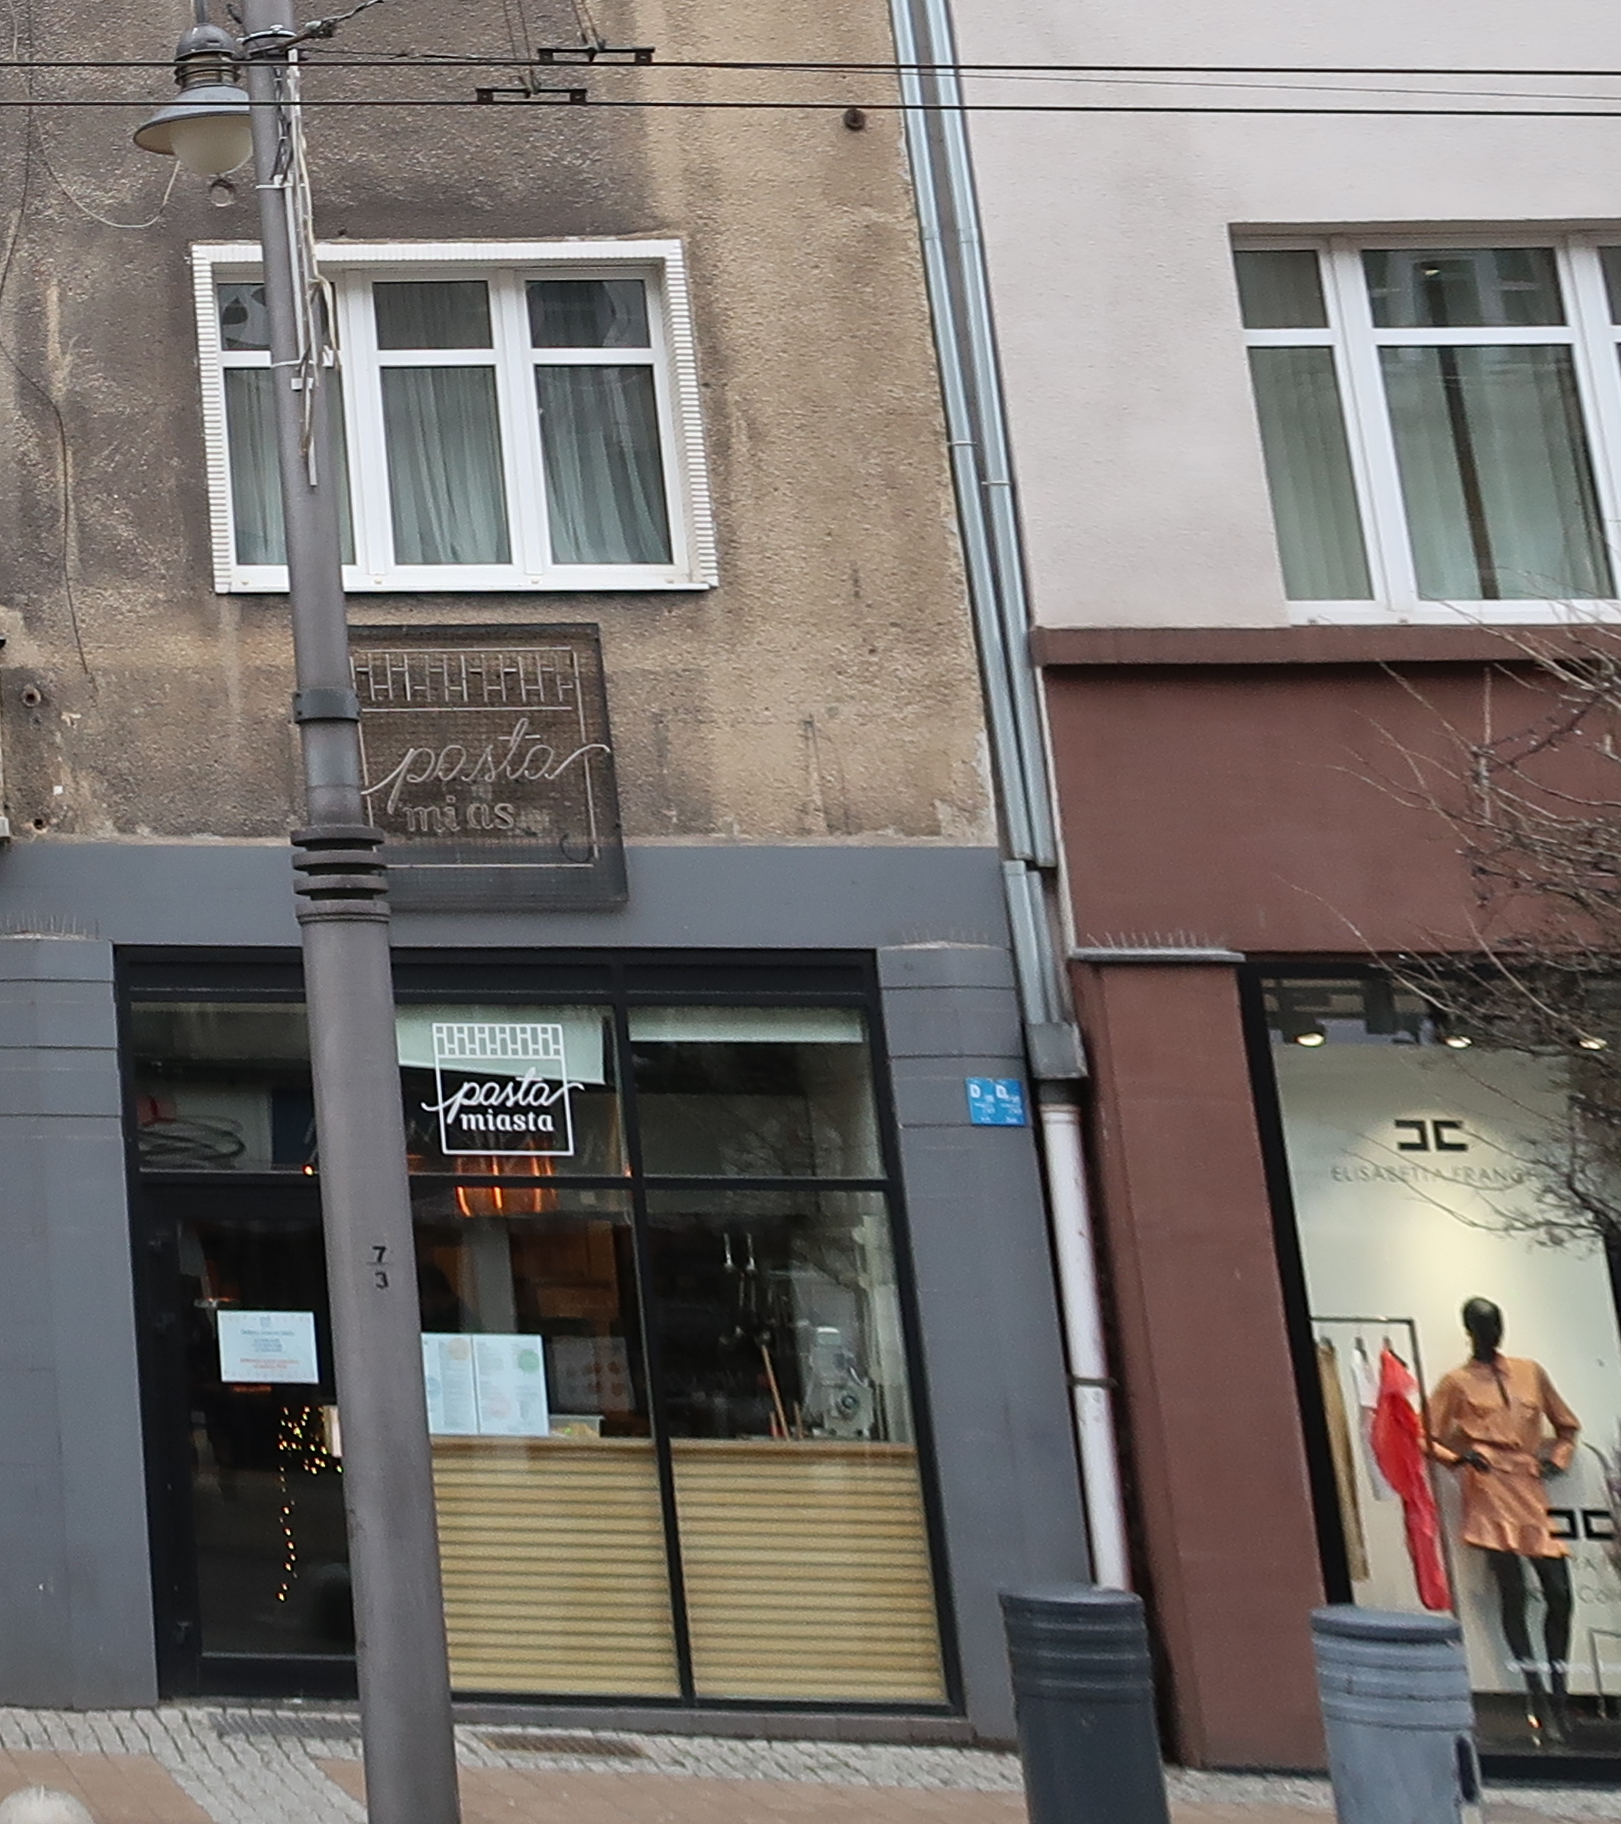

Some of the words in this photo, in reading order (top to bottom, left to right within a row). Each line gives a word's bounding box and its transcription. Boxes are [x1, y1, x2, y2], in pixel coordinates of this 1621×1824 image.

[361, 717, 611, 815] pasta
[421, 1067, 585, 1125] pasta
[460, 1109, 555, 1132] miasta
[372, 1245, 387, 1264] 7
[374, 1272, 389, 1290] 3
